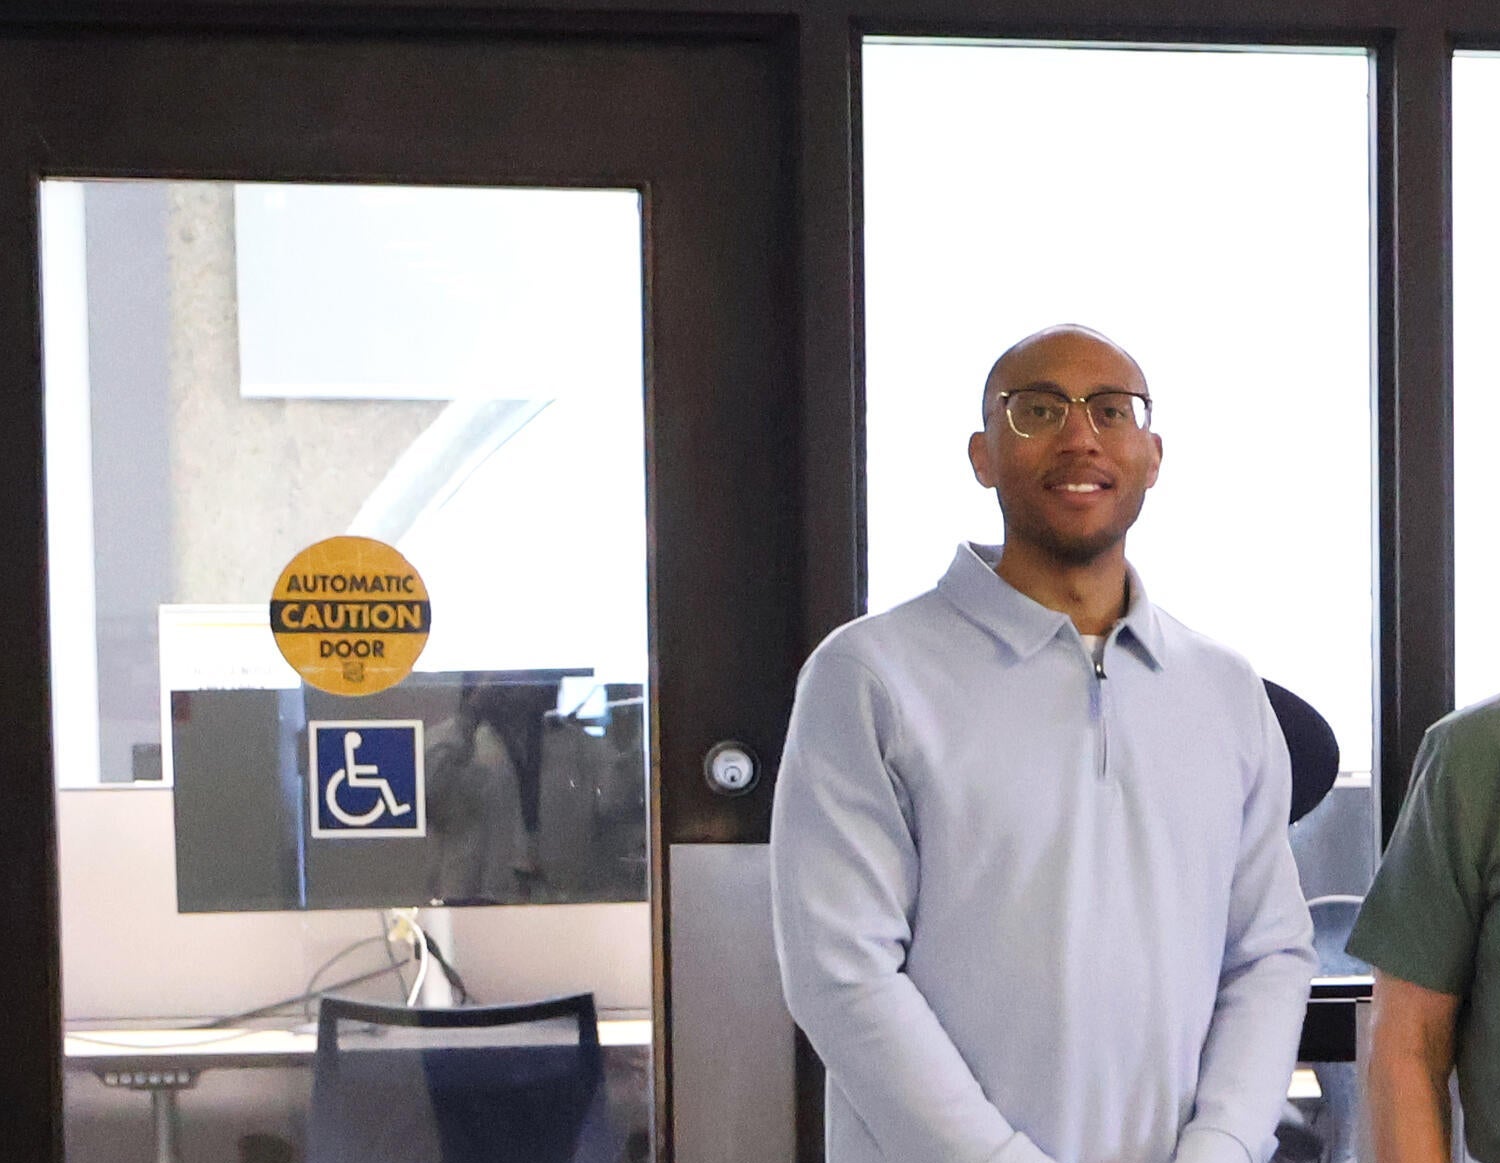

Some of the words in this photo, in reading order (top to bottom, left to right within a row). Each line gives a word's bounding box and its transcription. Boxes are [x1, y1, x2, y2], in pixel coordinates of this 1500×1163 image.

[287, 574, 414, 593] AUTOMATIC
[281, 602, 422, 630] CAUTION
[320, 640, 385, 659] DOOR
